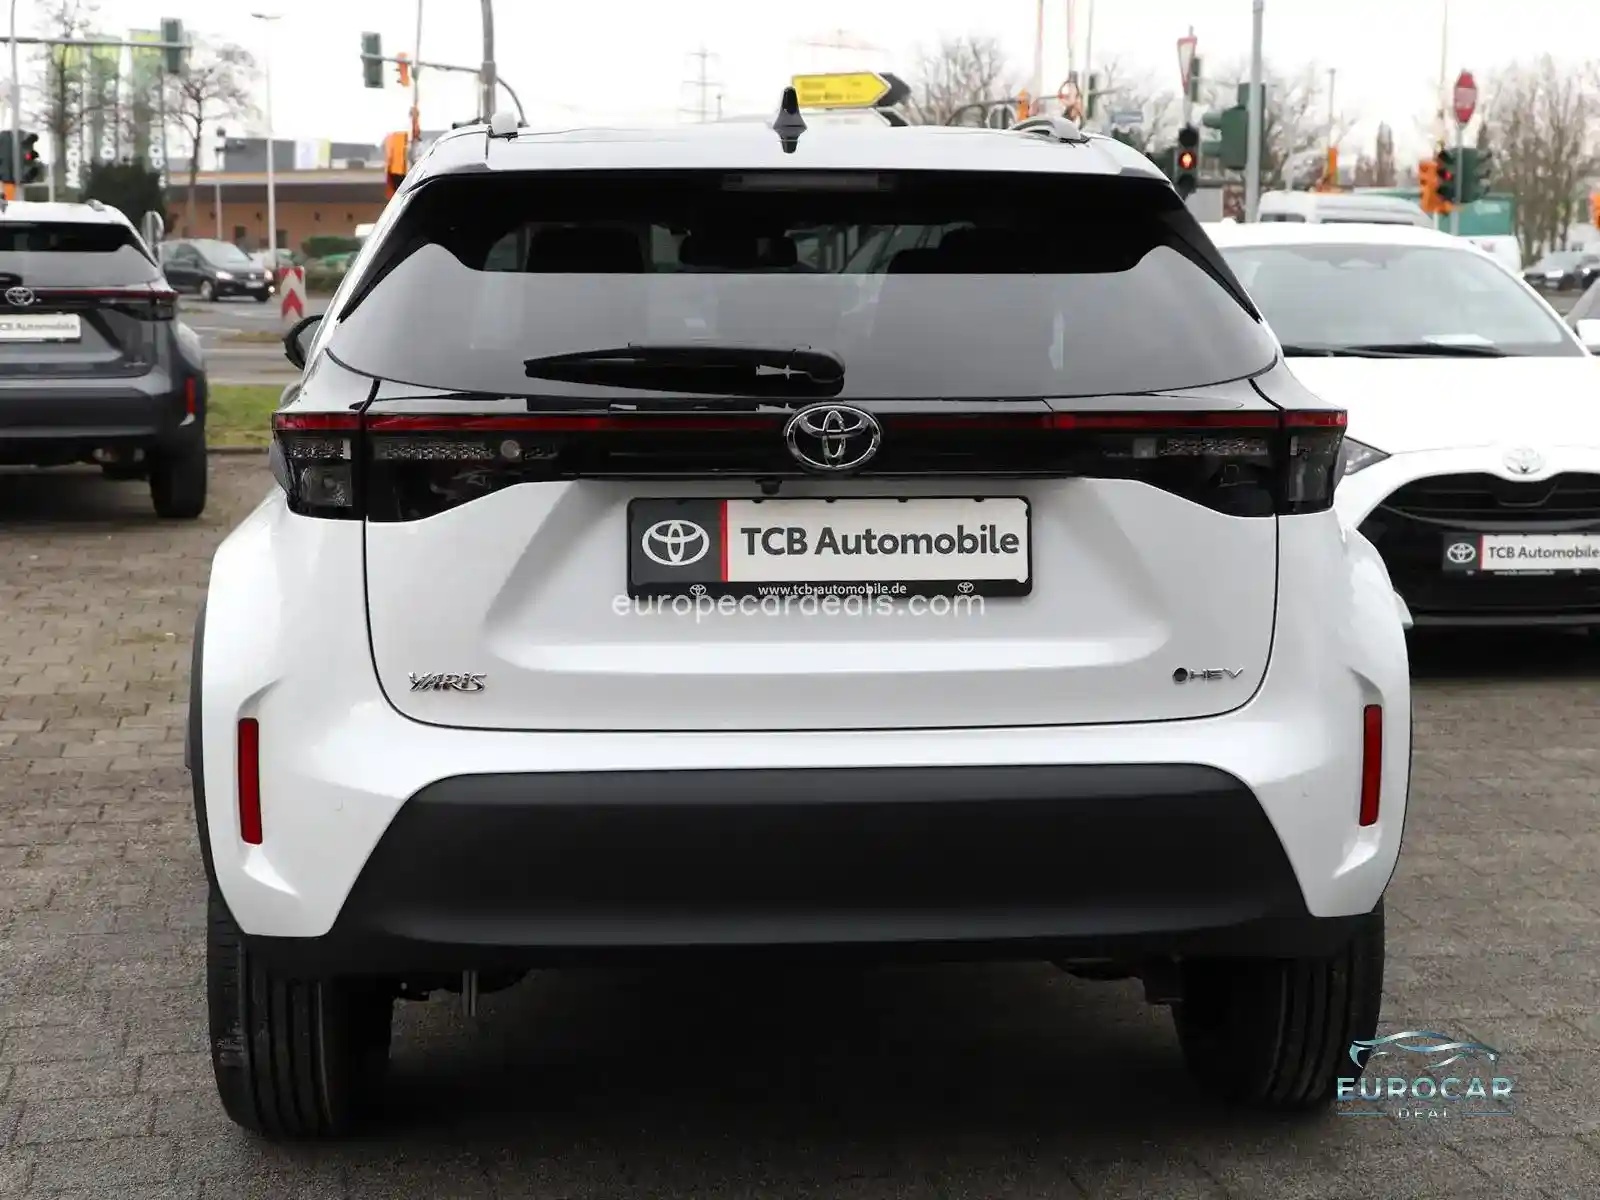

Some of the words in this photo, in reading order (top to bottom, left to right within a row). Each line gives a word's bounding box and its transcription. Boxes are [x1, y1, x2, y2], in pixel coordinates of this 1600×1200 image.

[741, 527, 808, 555] TCB
[814, 524, 1020, 555] Automobile
[1488, 546, 1515, 559] TCB
[1518, 543, 1600, 559] Automobile
